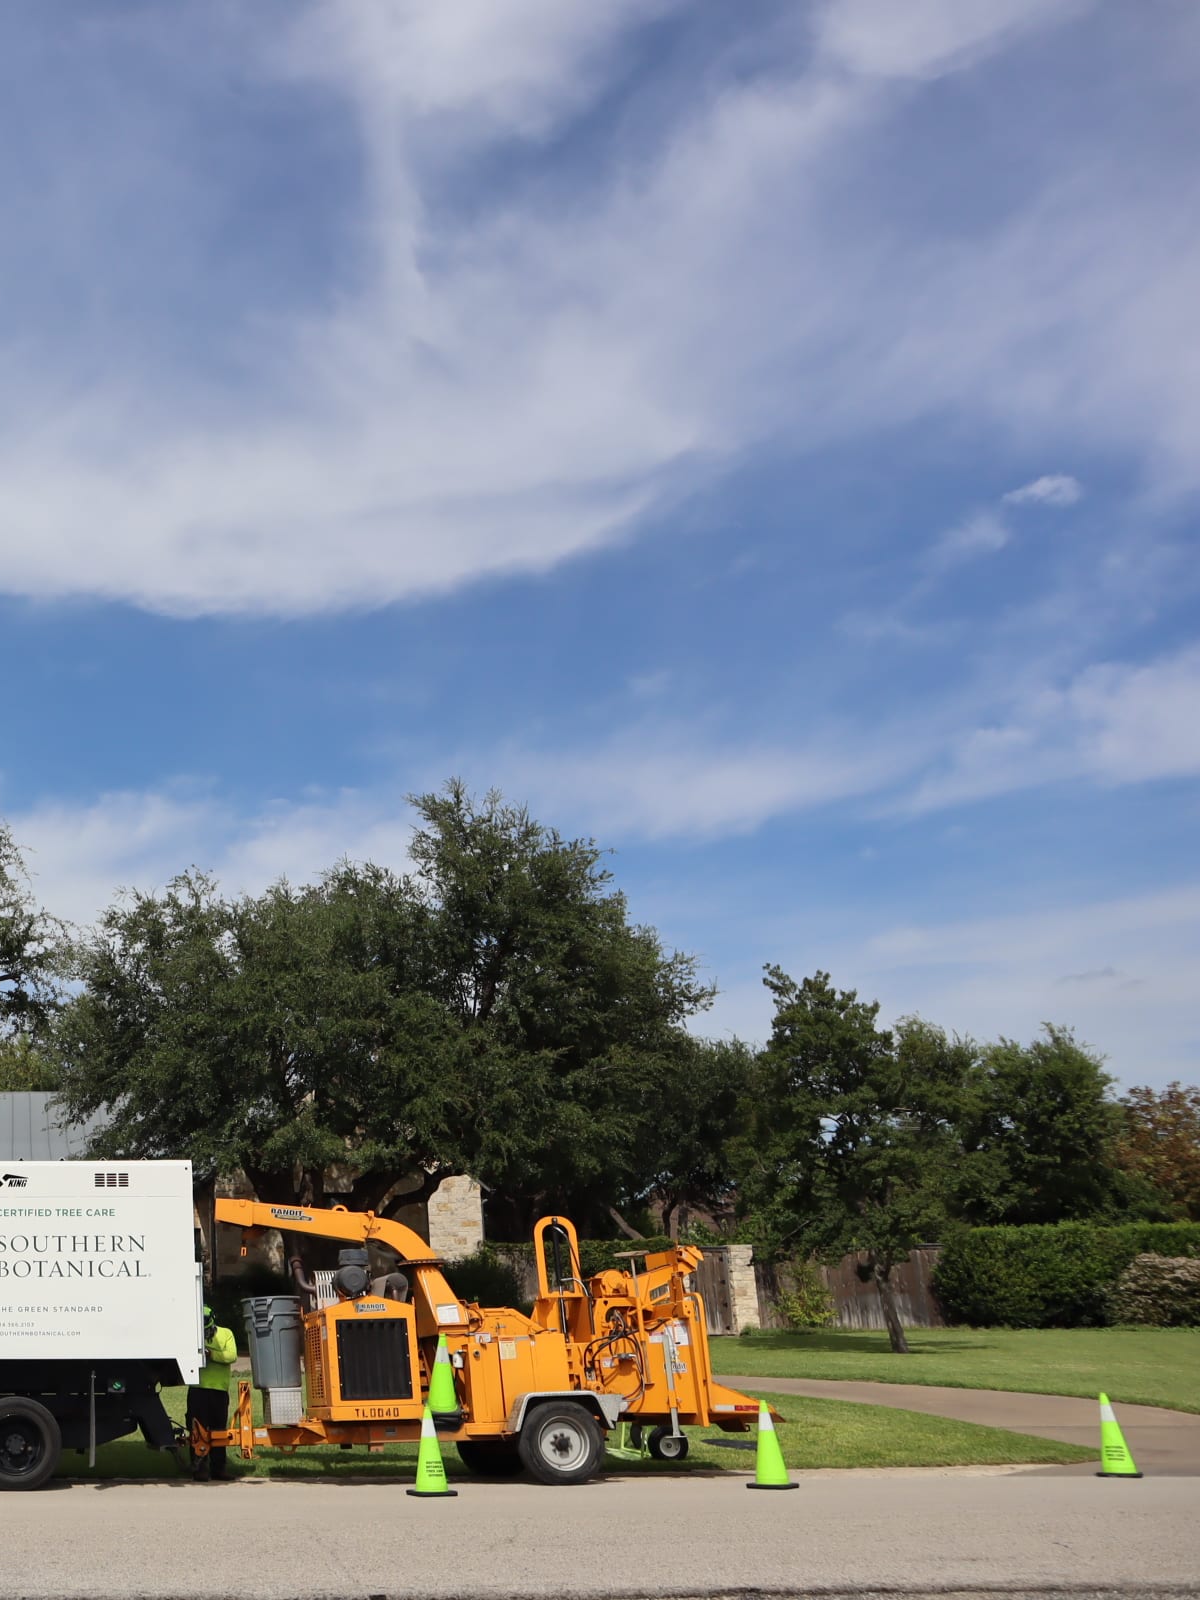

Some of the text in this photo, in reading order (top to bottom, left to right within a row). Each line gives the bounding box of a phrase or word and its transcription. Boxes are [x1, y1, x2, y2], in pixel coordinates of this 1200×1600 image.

[8, 1179, 28, 1188] KING
[55, 1208, 83, 1217] TREE
[86, 1208, 116, 1217] CARE
[271, 1208, 303, 1216] BANDIT
